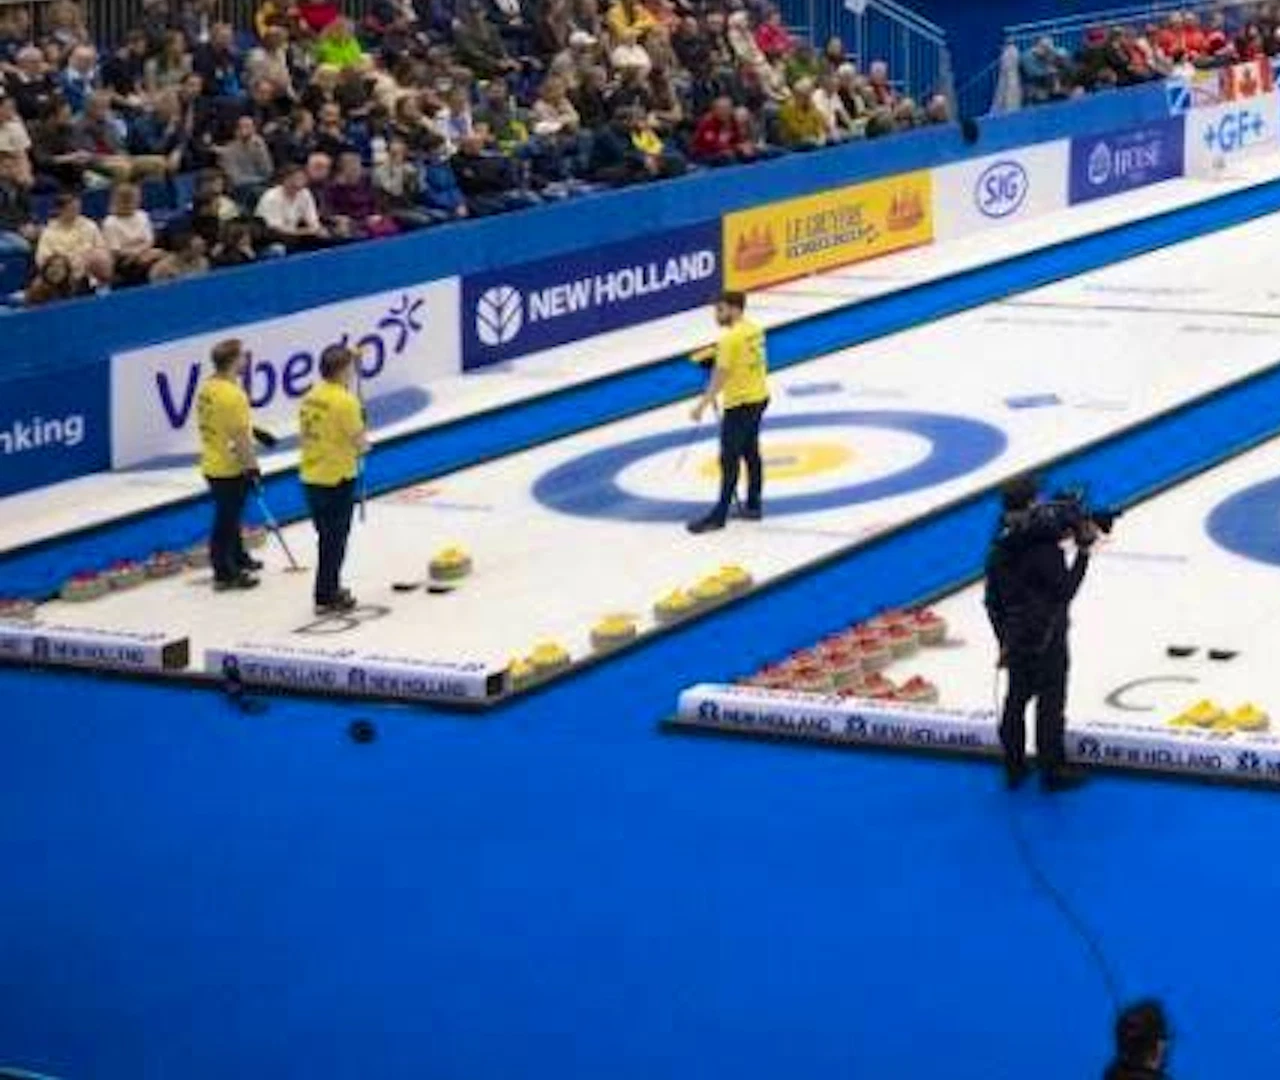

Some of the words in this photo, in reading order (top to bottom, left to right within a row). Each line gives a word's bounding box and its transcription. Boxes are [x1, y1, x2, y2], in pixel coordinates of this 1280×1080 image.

[984, 171, 1018, 207] SIG
[529, 278, 590, 321] NEW
[595, 250, 716, 305] HOLLAND
